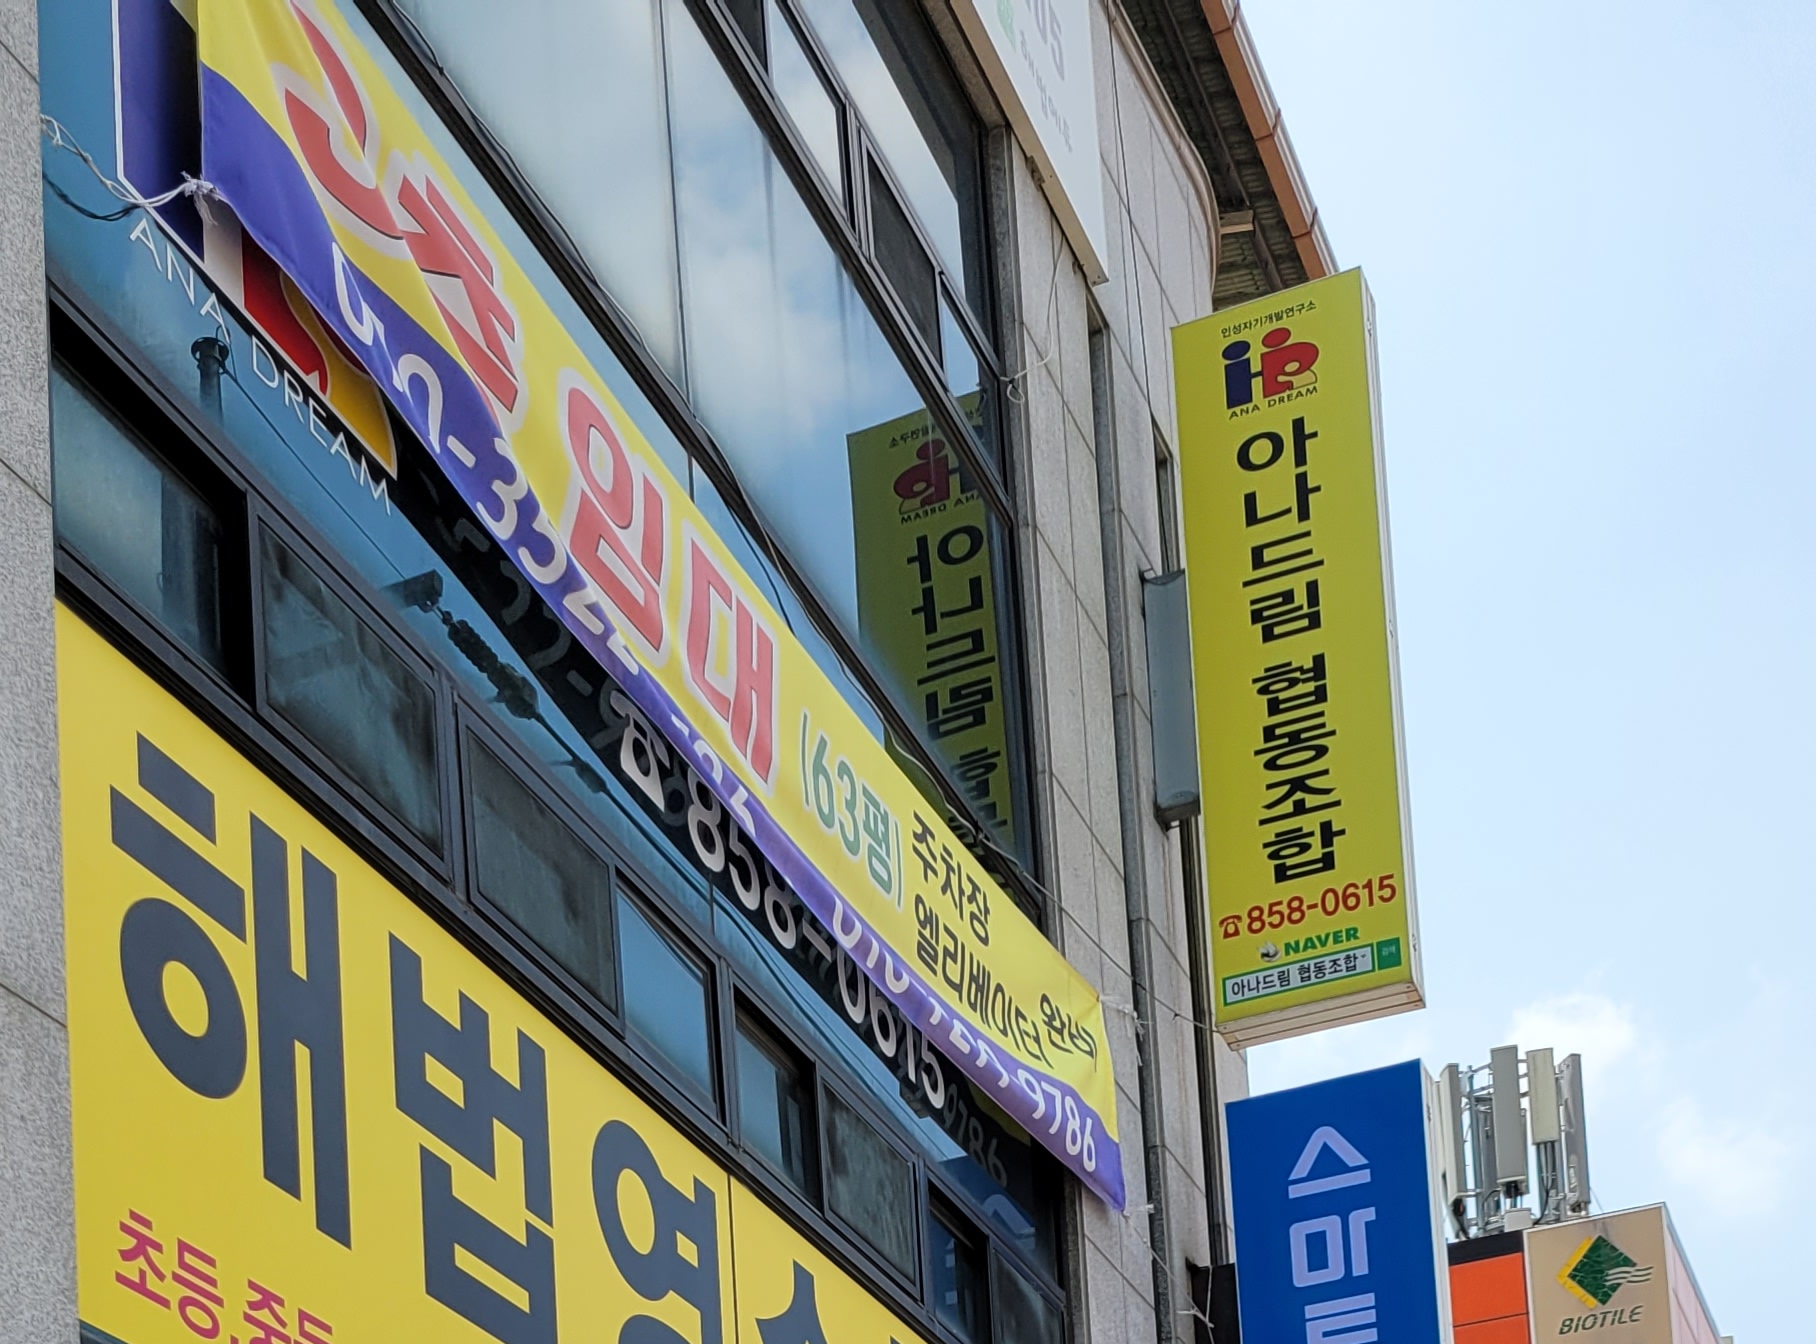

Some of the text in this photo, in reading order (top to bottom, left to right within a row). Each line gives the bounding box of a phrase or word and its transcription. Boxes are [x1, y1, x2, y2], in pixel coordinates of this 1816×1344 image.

[1220, 300, 1318, 338] 인성자기개발연구소
[129, 219, 392, 516] ANA DREAM
[1228, 385, 1319, 421] ANA DREAM
[567, 388, 774, 784] 임대
[801, 711, 903, 911] (63평)
[1235, 416, 1347, 884] 아나드림 협동조합
[911, 810, 991, 947] 주차장
[1245, 873, 1398, 937] 858-0615
[1283, 926, 1361, 957] NAVER
[914, 893, 1054, 1069] 엘리베이터
[1230, 968, 1291, 999] 아나드림
[1298, 954, 1359, 984] 협동조합
[1558, 1304, 1645, 1336] BIOTILE
